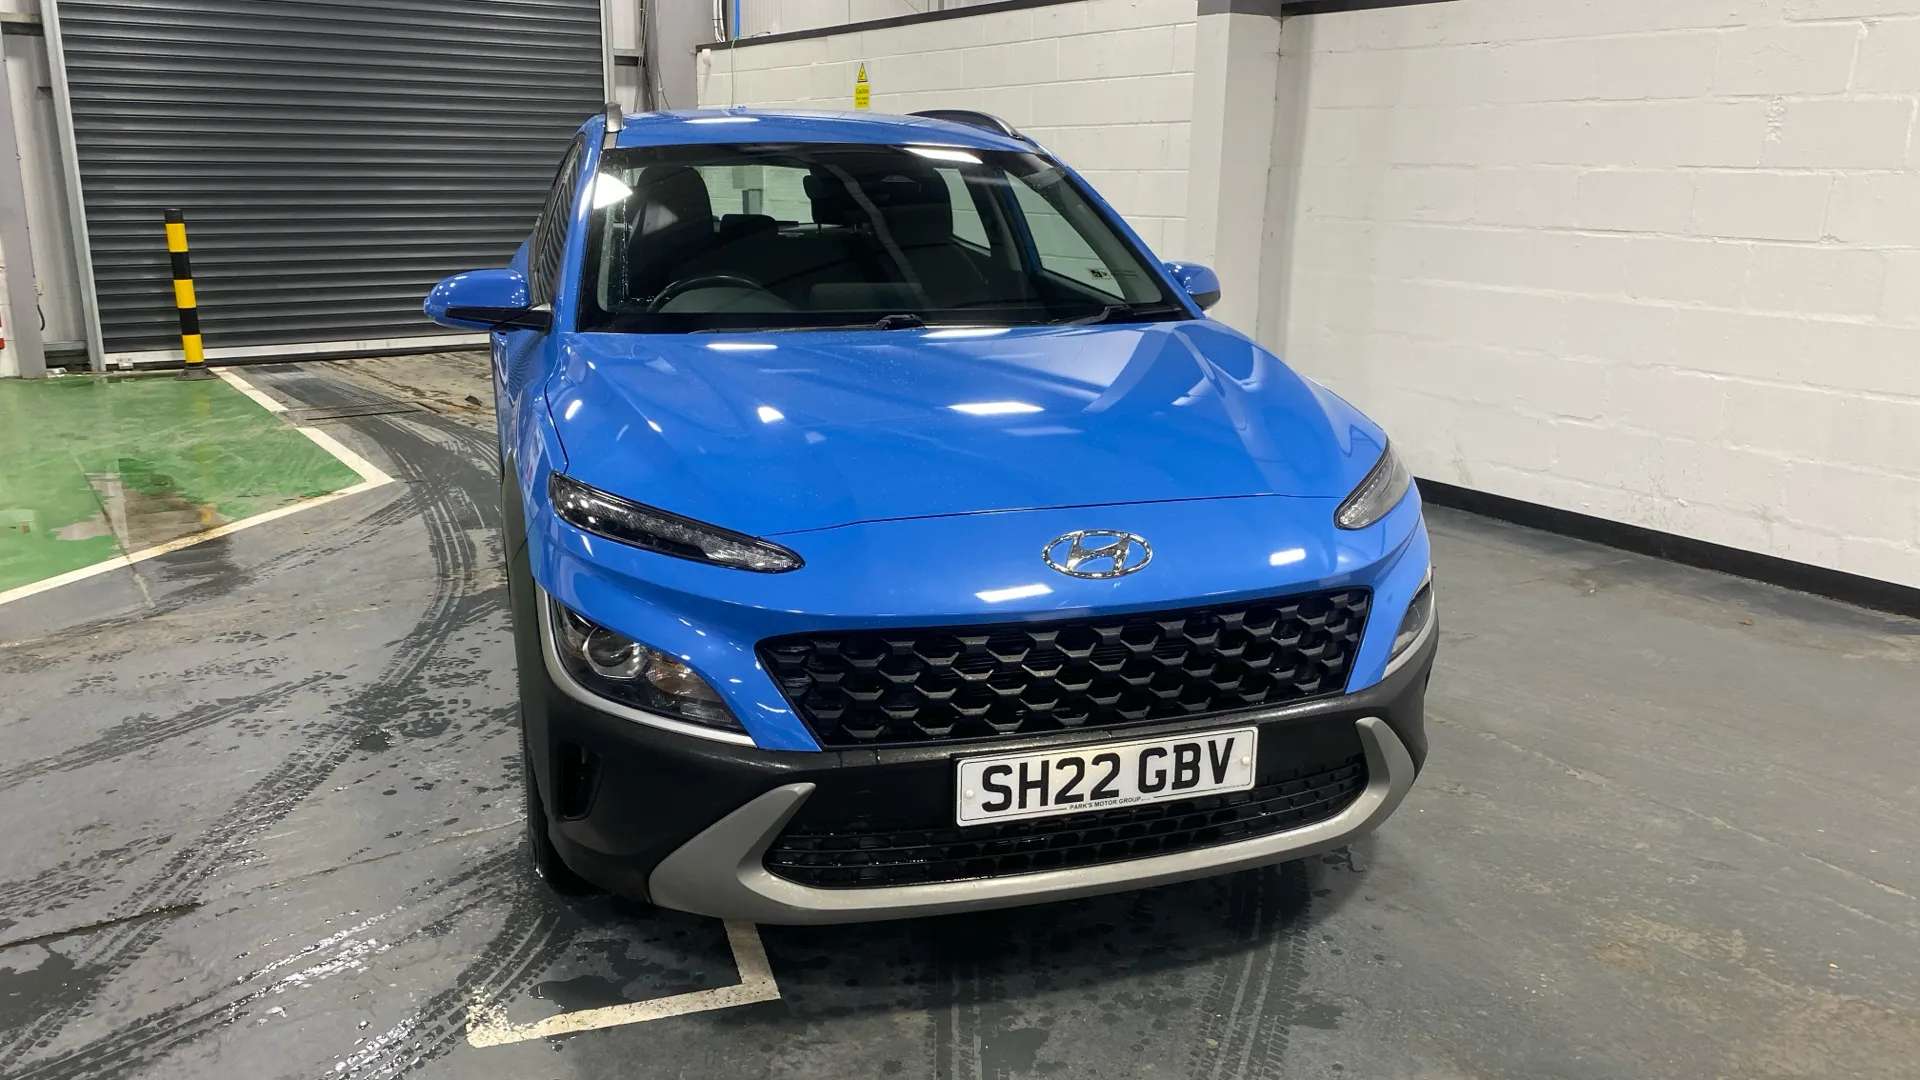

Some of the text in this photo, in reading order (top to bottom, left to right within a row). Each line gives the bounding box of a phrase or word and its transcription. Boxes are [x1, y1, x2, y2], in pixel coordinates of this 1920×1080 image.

[981, 737, 1235, 812] SH22 GBV
[1069, 801, 1093, 810] PARK'S
[1094, 799, 1117, 807] MOTOR
[1118, 796, 1142, 804] GROUP
